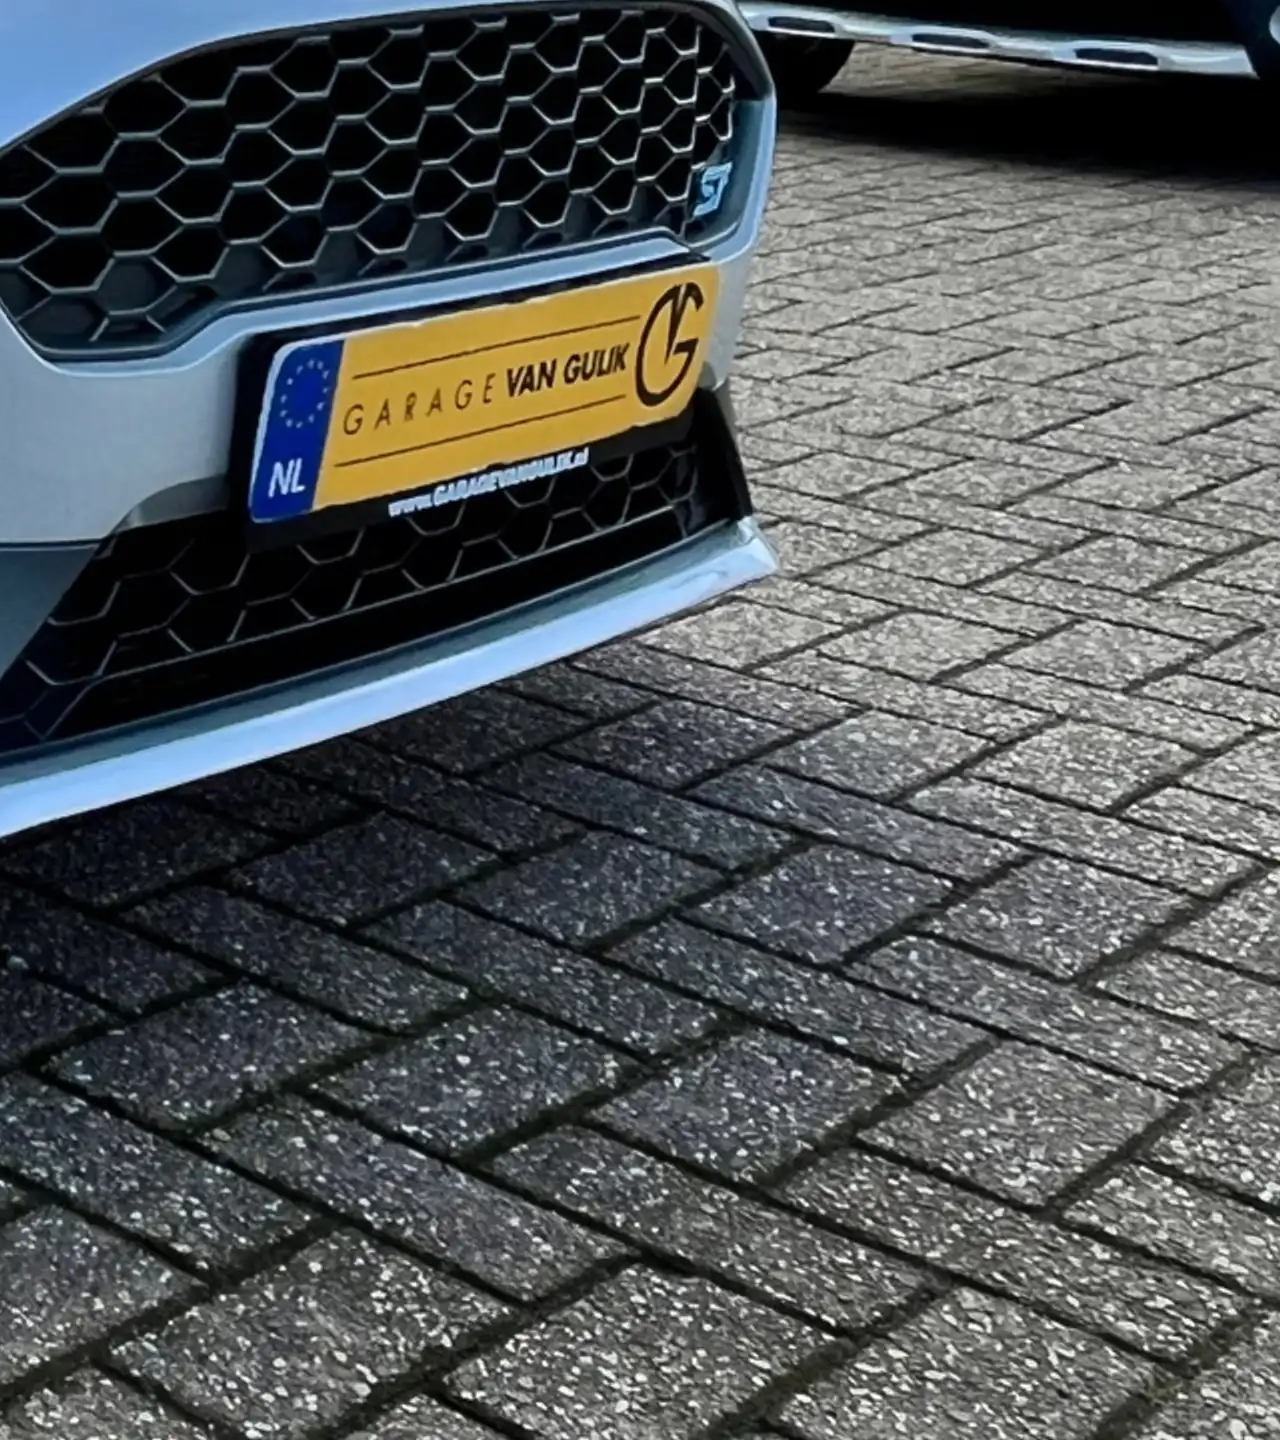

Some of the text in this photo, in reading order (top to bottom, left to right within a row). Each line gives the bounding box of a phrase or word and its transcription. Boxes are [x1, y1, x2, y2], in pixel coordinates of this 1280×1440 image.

[343, 373, 496, 436] GARAGE
[506, 357, 557, 398] VAN
[563, 342, 630, 384] GULIK
[268, 458, 306, 498] NL
